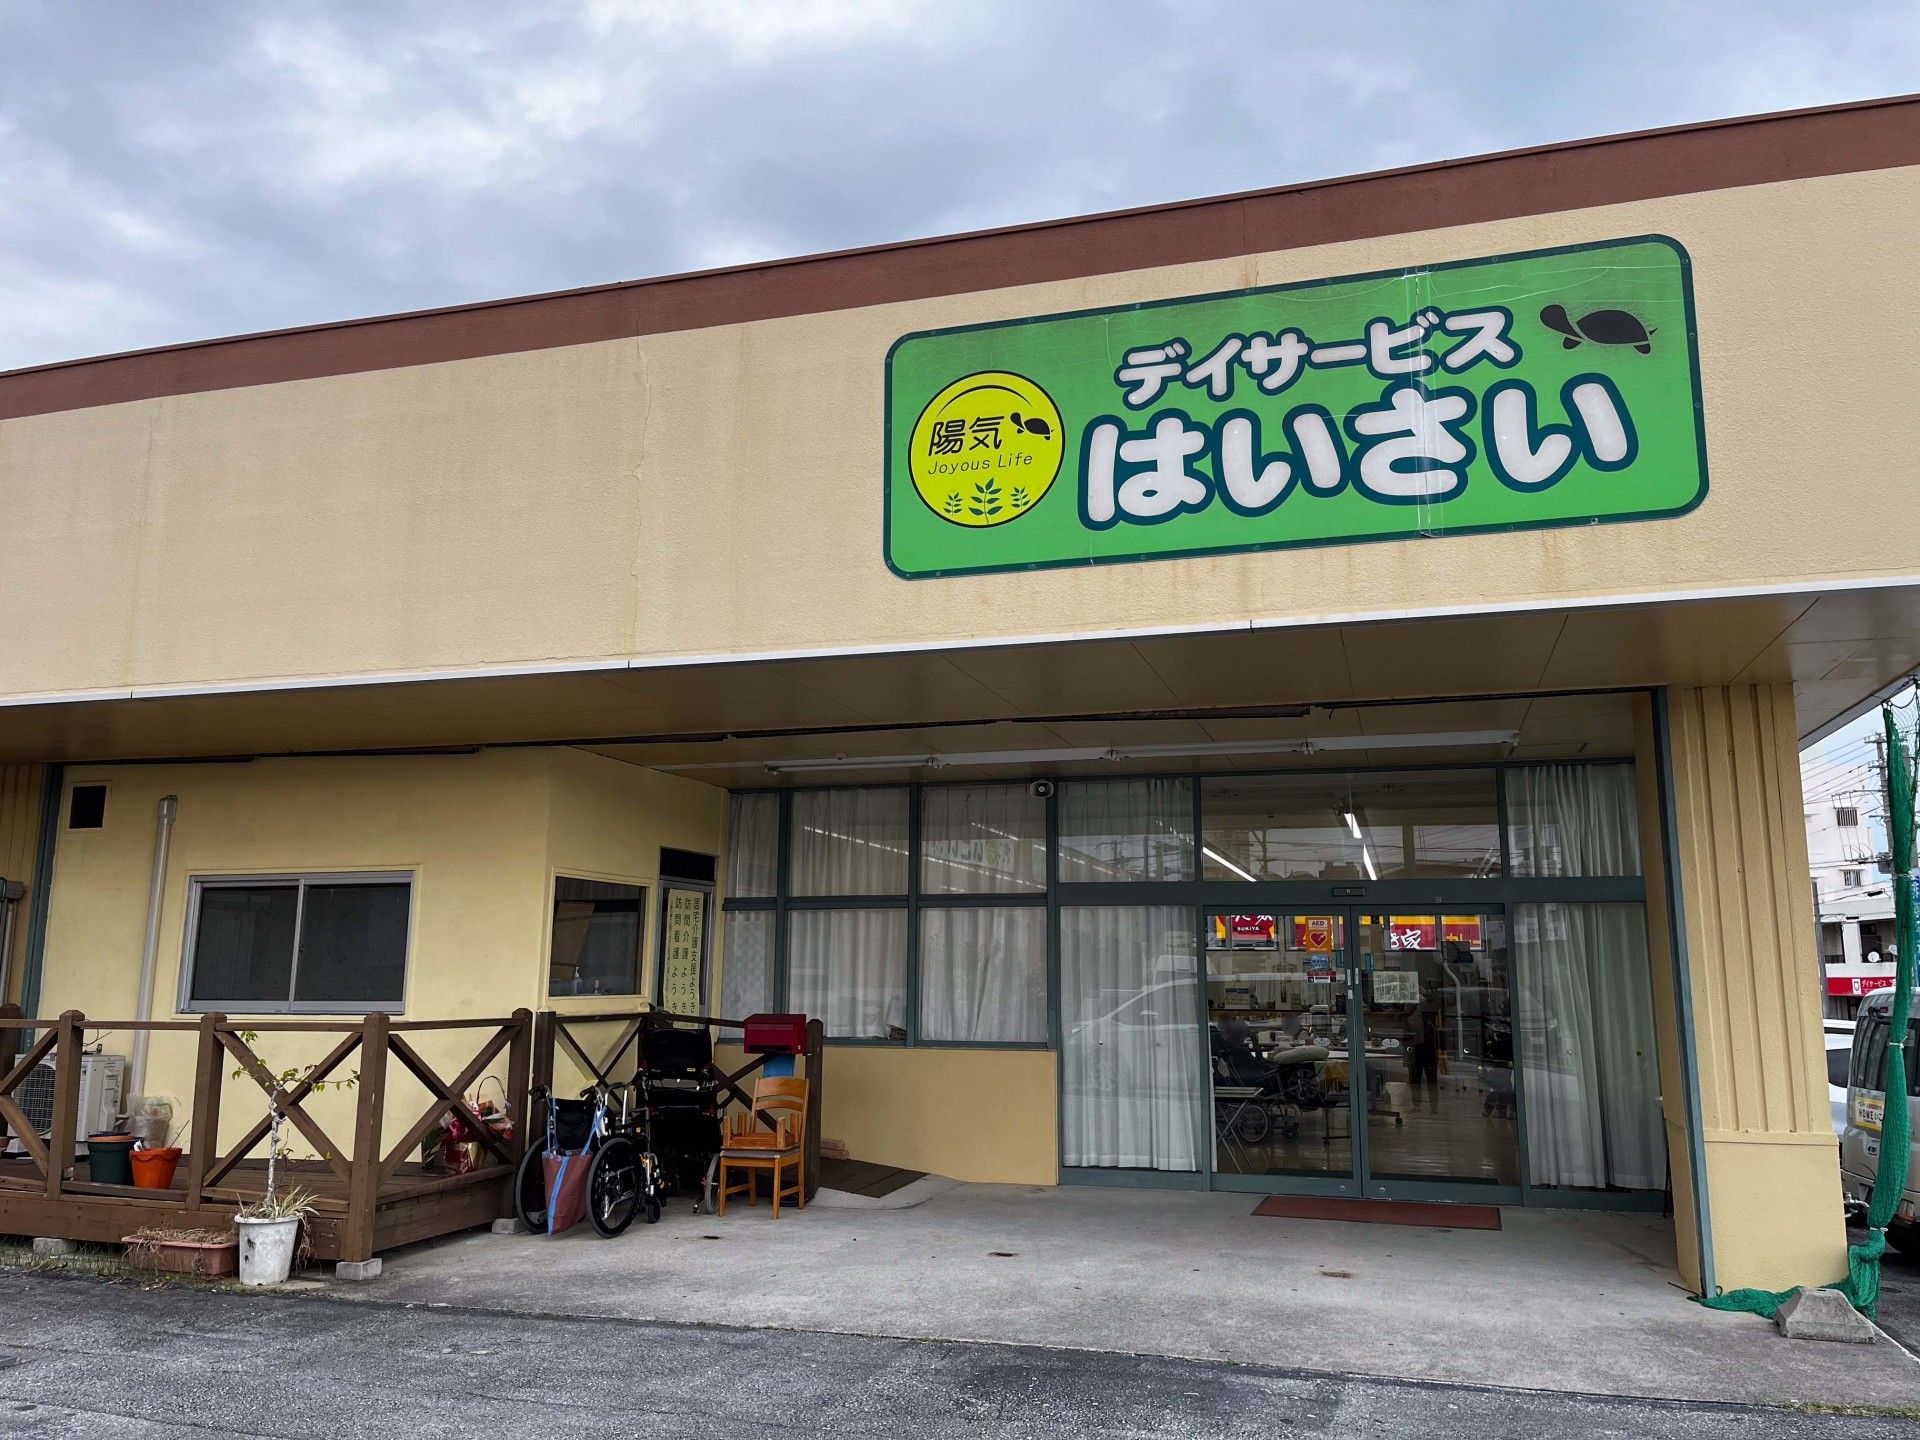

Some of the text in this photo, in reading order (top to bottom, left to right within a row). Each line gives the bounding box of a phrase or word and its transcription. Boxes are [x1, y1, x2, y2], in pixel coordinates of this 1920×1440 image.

[1117, 309, 1517, 408] デイサービス
[927, 451, 1034, 475] Joyous Life
[928, 415, 1005, 457] 陽気
[1085, 380, 1631, 525] はいさい
